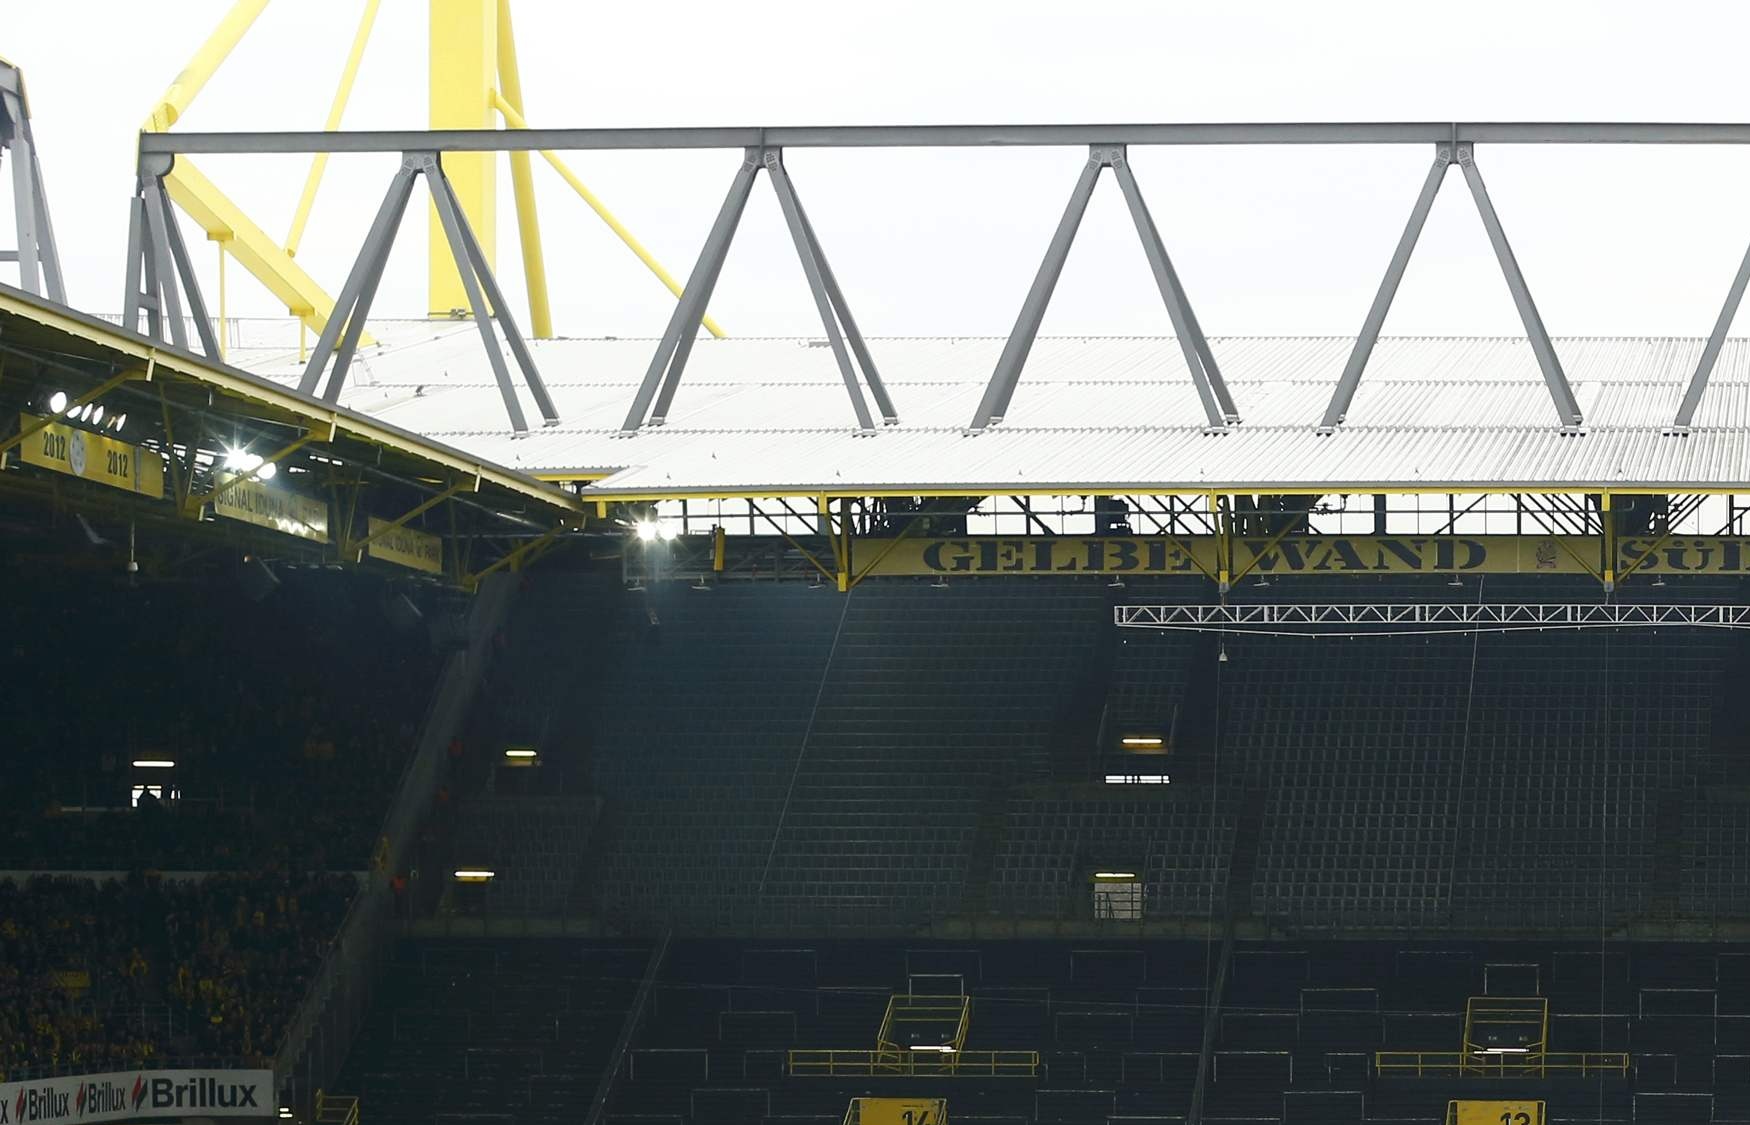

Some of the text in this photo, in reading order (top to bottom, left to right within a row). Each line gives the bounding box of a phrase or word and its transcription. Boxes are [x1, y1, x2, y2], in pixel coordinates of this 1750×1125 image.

[43, 431, 128, 478] 2012 2012
[921, 539, 1197, 573] GELBE
[1243, 538, 1488, 572] WAND
[29, 1087, 70, 1121] Brillux
[88, 1082, 126, 1114] Brillux
[151, 1077, 258, 1109] Brillux
